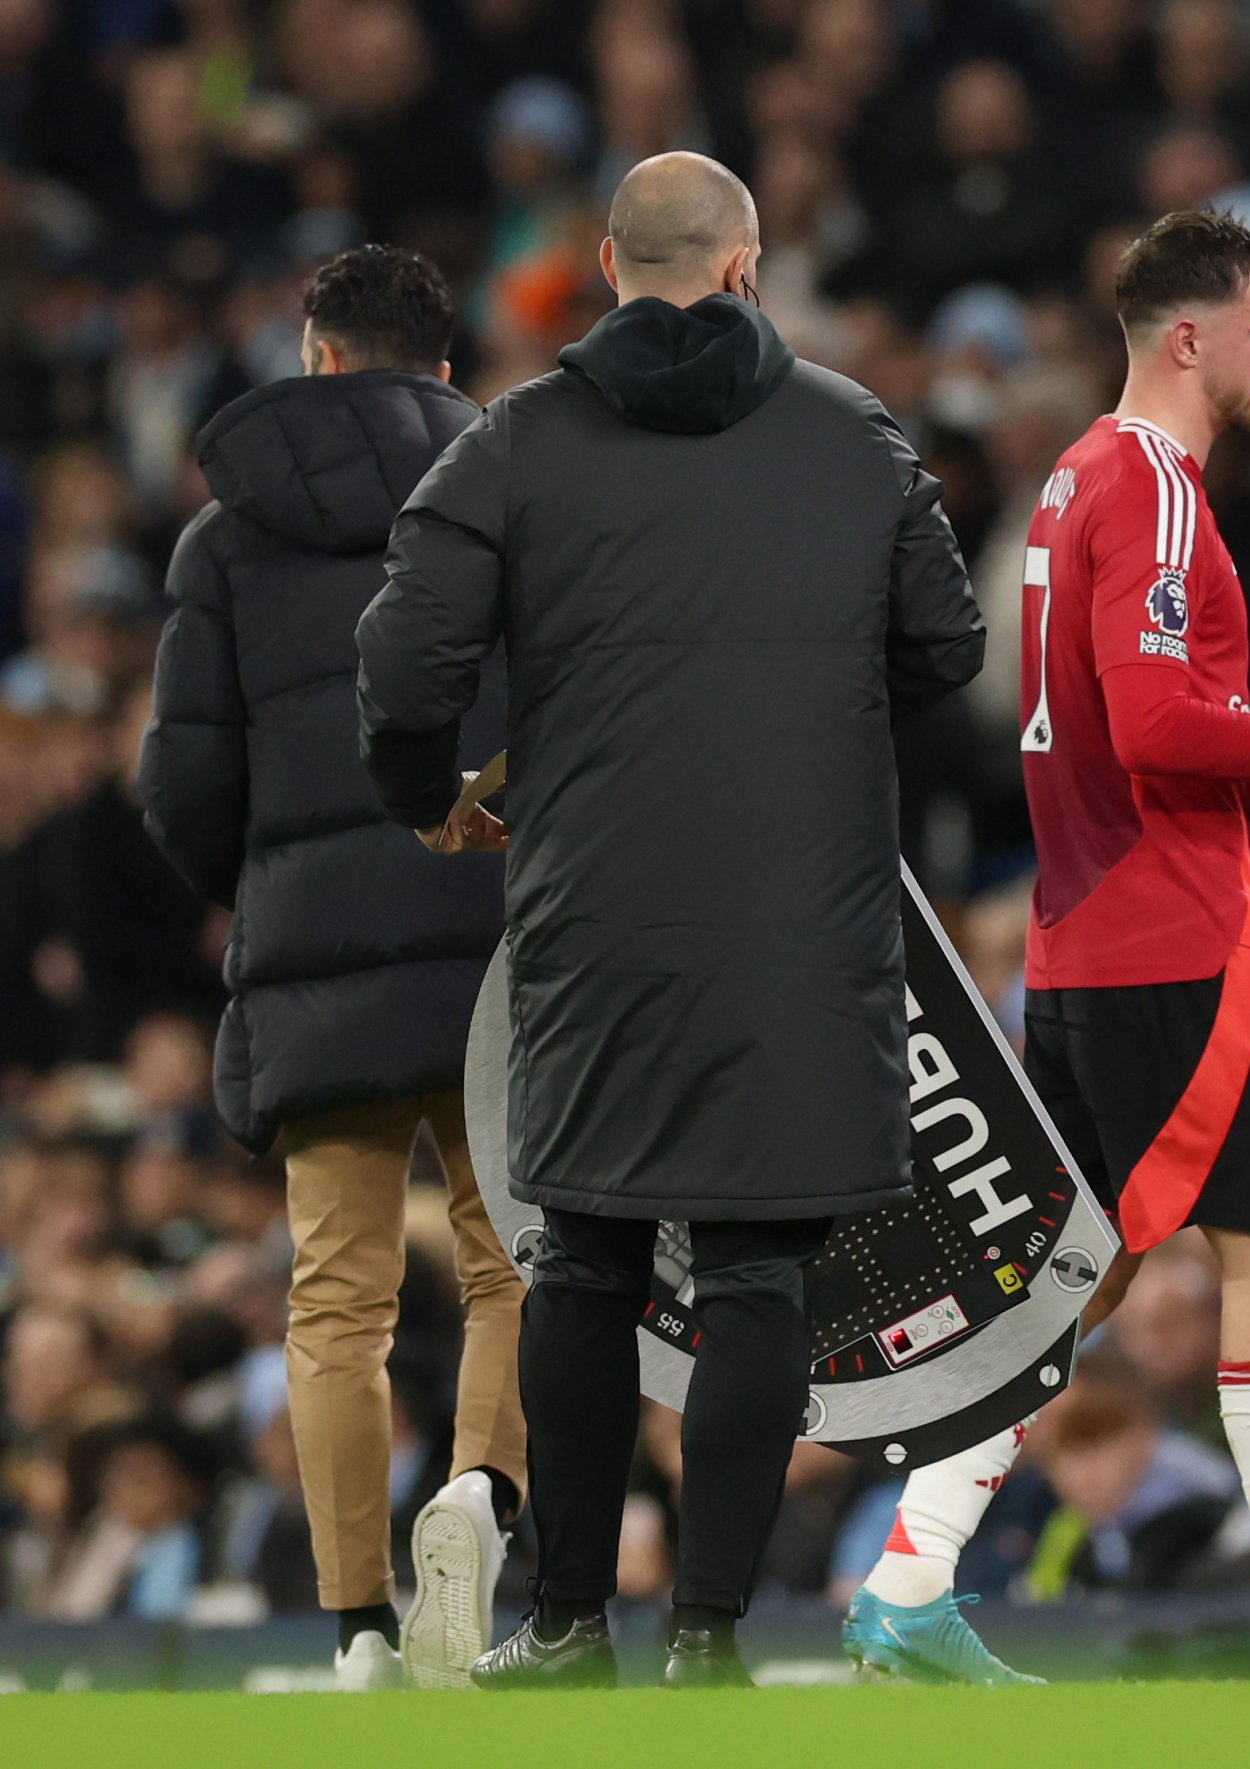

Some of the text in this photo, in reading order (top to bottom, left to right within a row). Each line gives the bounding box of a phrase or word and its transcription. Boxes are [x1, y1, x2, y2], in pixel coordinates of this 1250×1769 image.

[1140, 631, 1161, 644] No
[1020, 546, 1052, 753] 7
[1140, 641, 1160, 654] for
[1025, 1231, 1047, 1257] 40
[1003, 1273, 1017, 1287] C
[657, 1312, 685, 1337] 55
